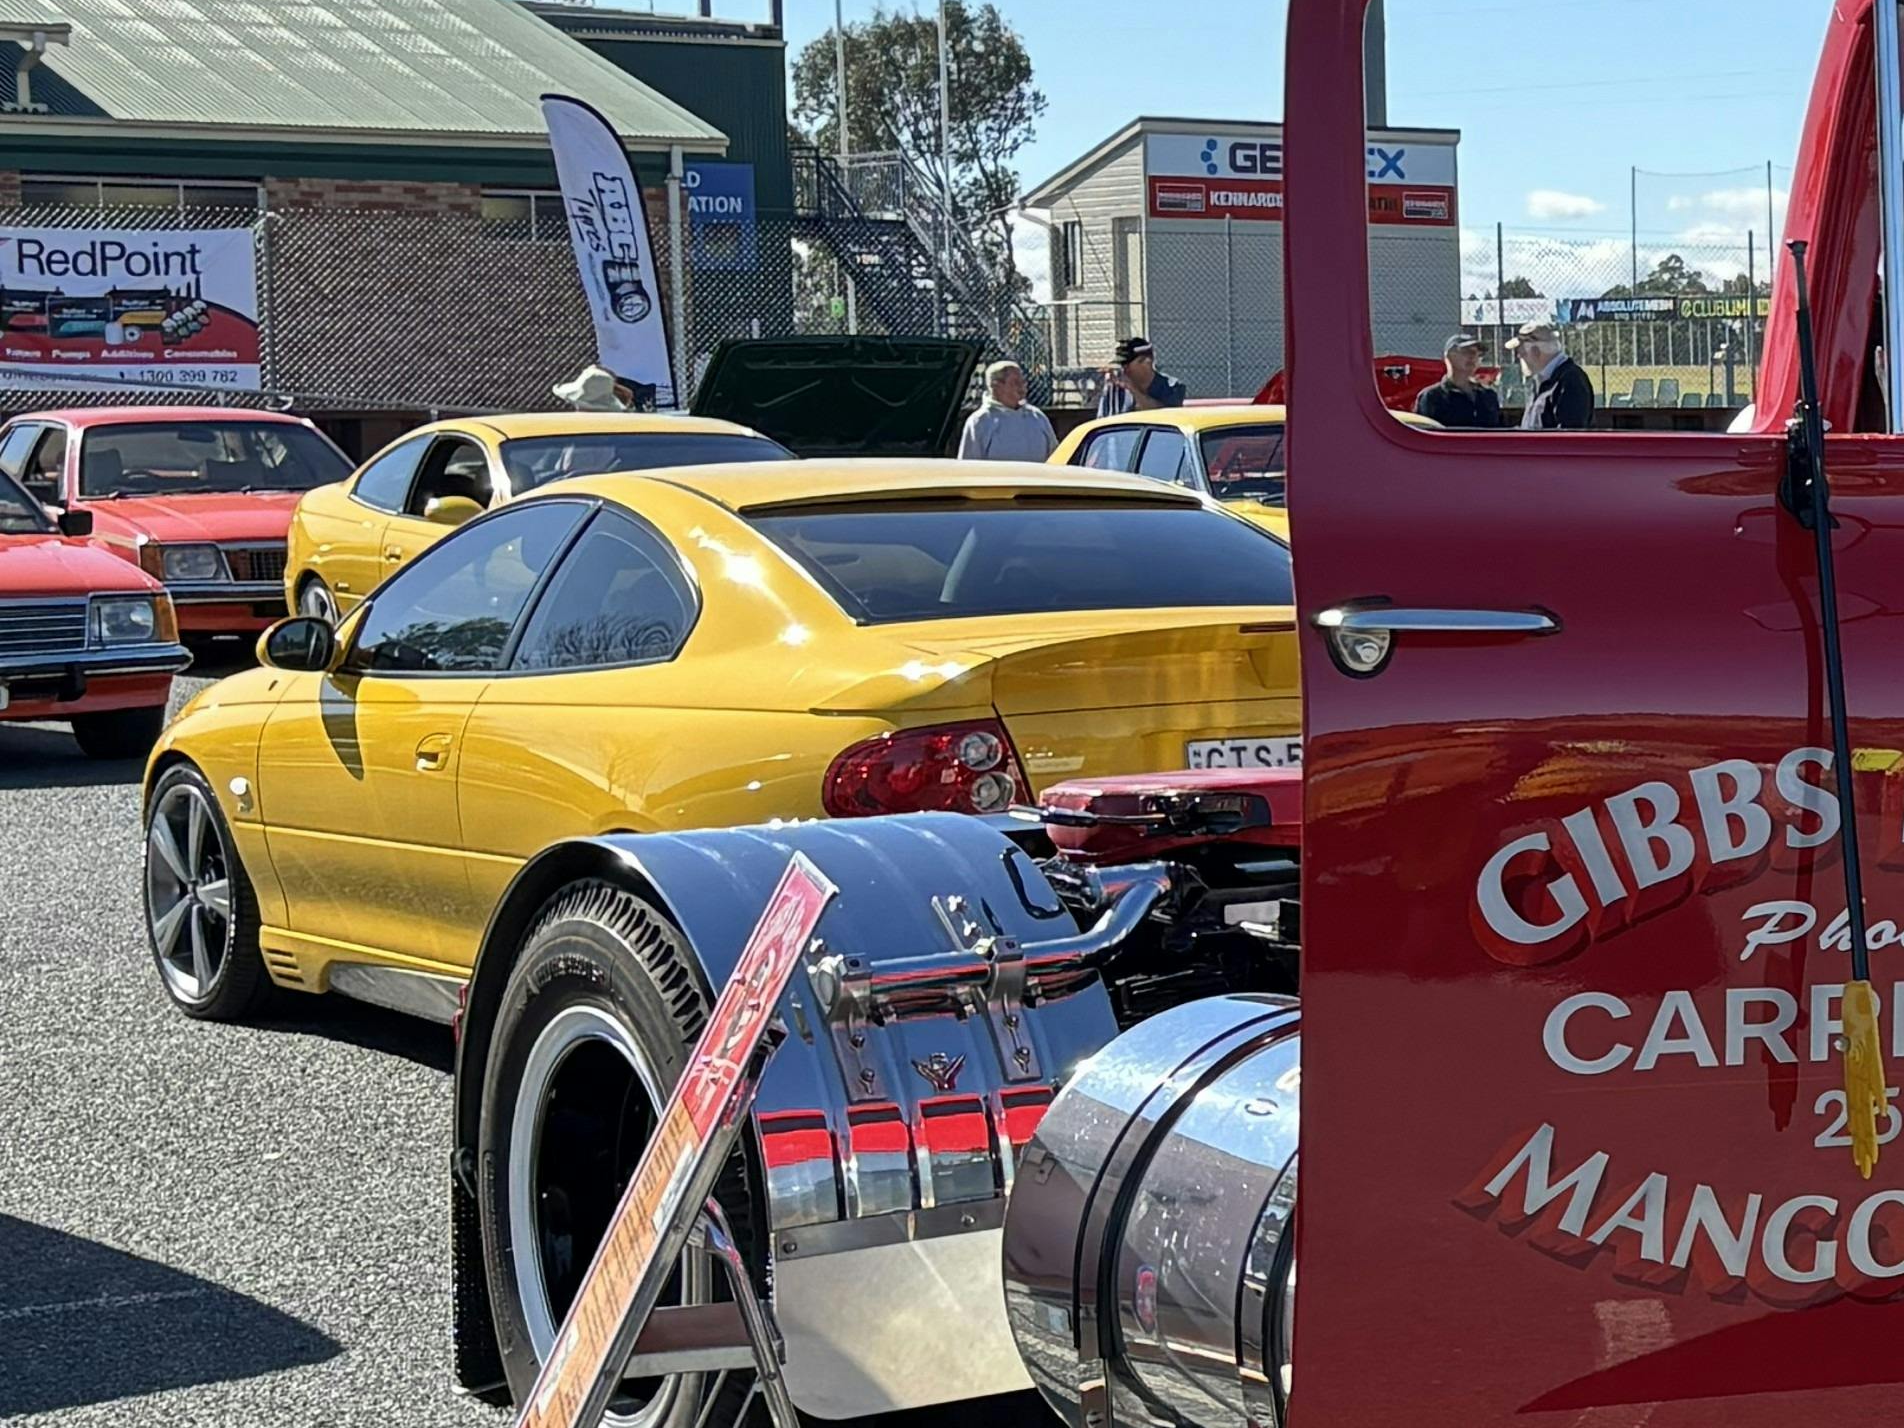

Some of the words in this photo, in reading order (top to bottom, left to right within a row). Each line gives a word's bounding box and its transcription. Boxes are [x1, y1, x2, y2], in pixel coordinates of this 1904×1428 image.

[593, 172, 638, 260] ABC
[687, 195, 743, 214] ATION
[16, 237, 203, 277] RedPoint
[1474, 746, 1846, 946] GIBBS
[1813, 1087, 1903, 1149] 25
